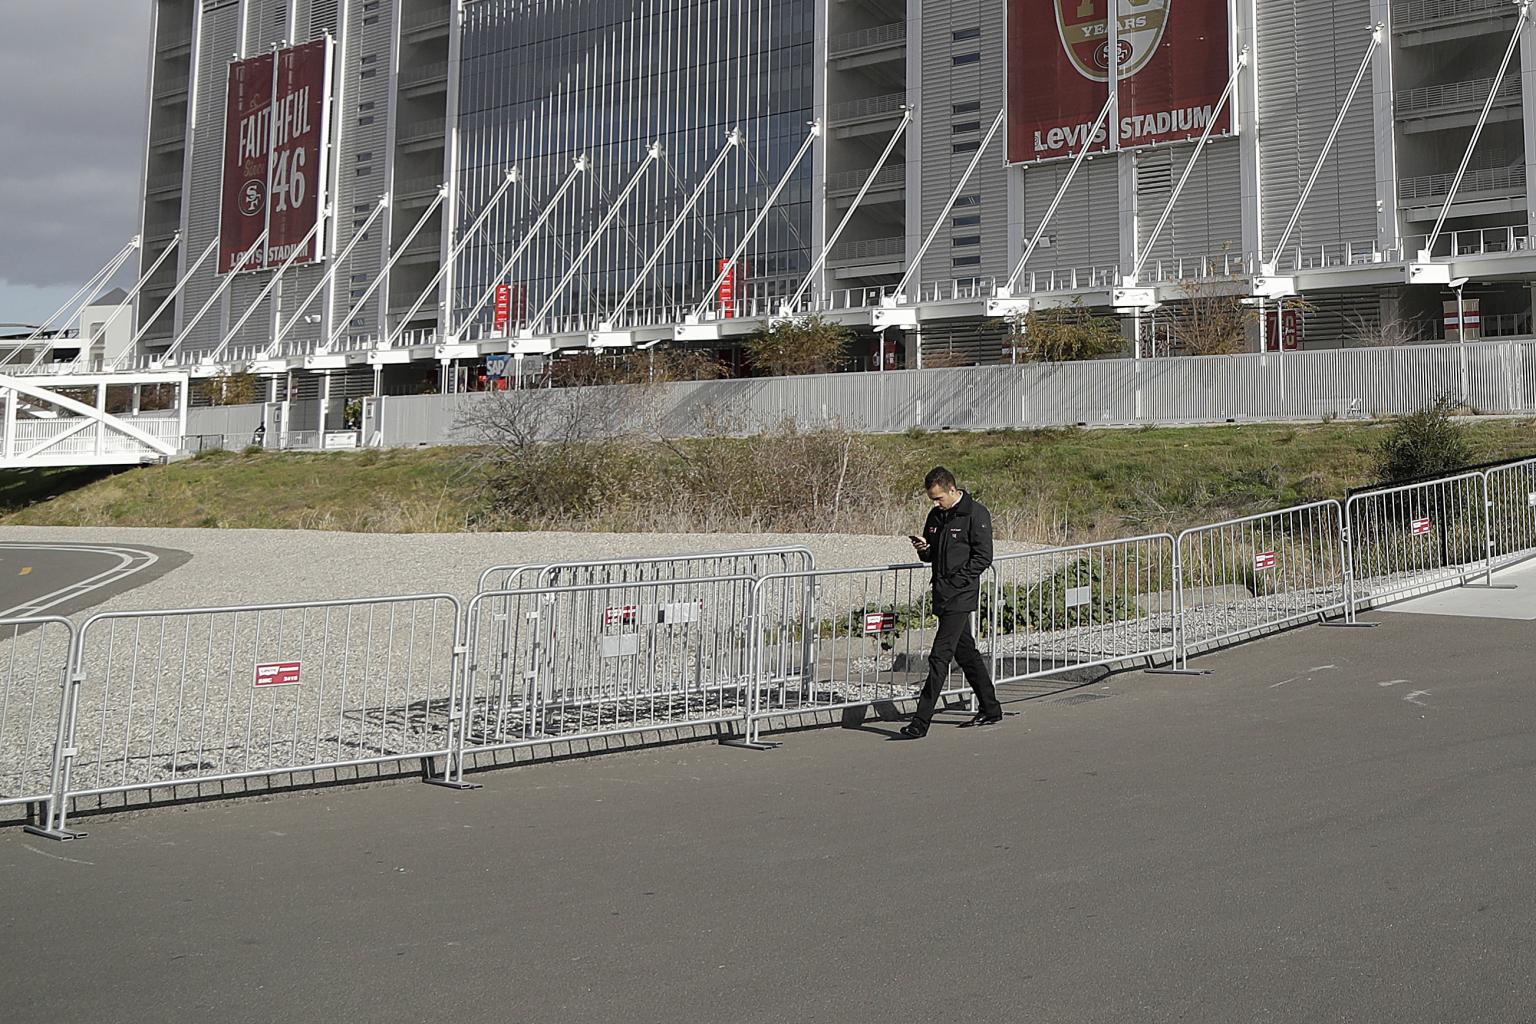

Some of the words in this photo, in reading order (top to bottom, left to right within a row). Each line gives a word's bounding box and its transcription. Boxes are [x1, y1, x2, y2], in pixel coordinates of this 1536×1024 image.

[238, 86, 310, 167] FAITHFUL
[1120, 105, 1213, 139] STADIUM
[486, 359, 505, 376] SAP
